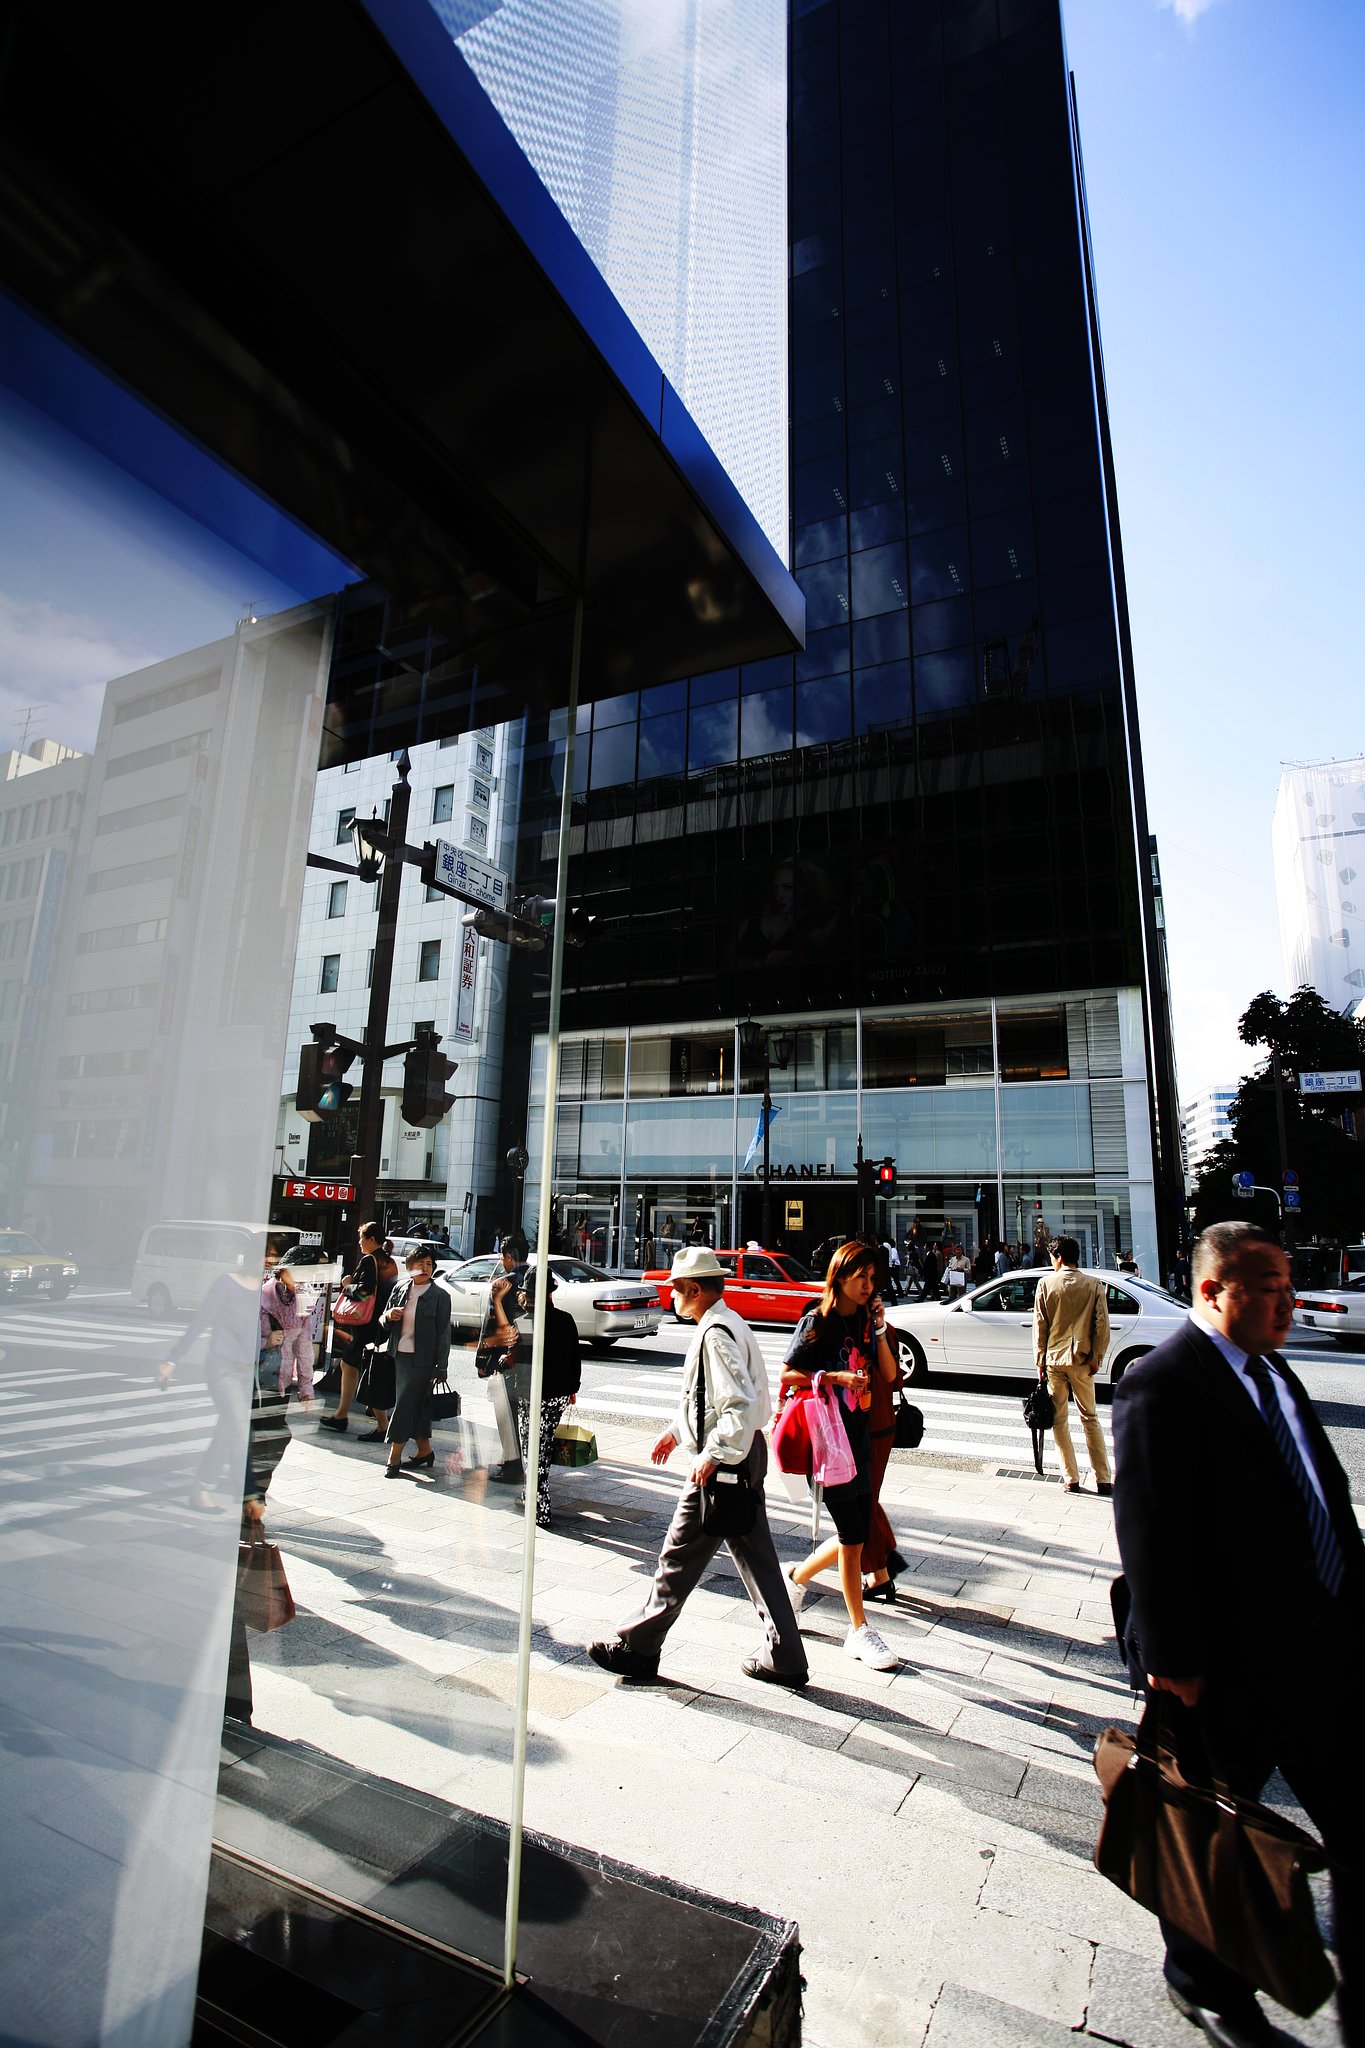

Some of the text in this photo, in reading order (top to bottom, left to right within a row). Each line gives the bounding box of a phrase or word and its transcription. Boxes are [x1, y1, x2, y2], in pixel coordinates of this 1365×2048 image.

[443, 843, 464, 860] 中央区
[442, 854, 503, 897] 銀座二丁目
[447, 873, 496, 903] Ginza 2-chome
[462, 928, 475, 990] 大和証券
[1304, 1076, 1357, 1087] 銀座二丁目
[292, 1183, 335, 1198] 宝くじ
